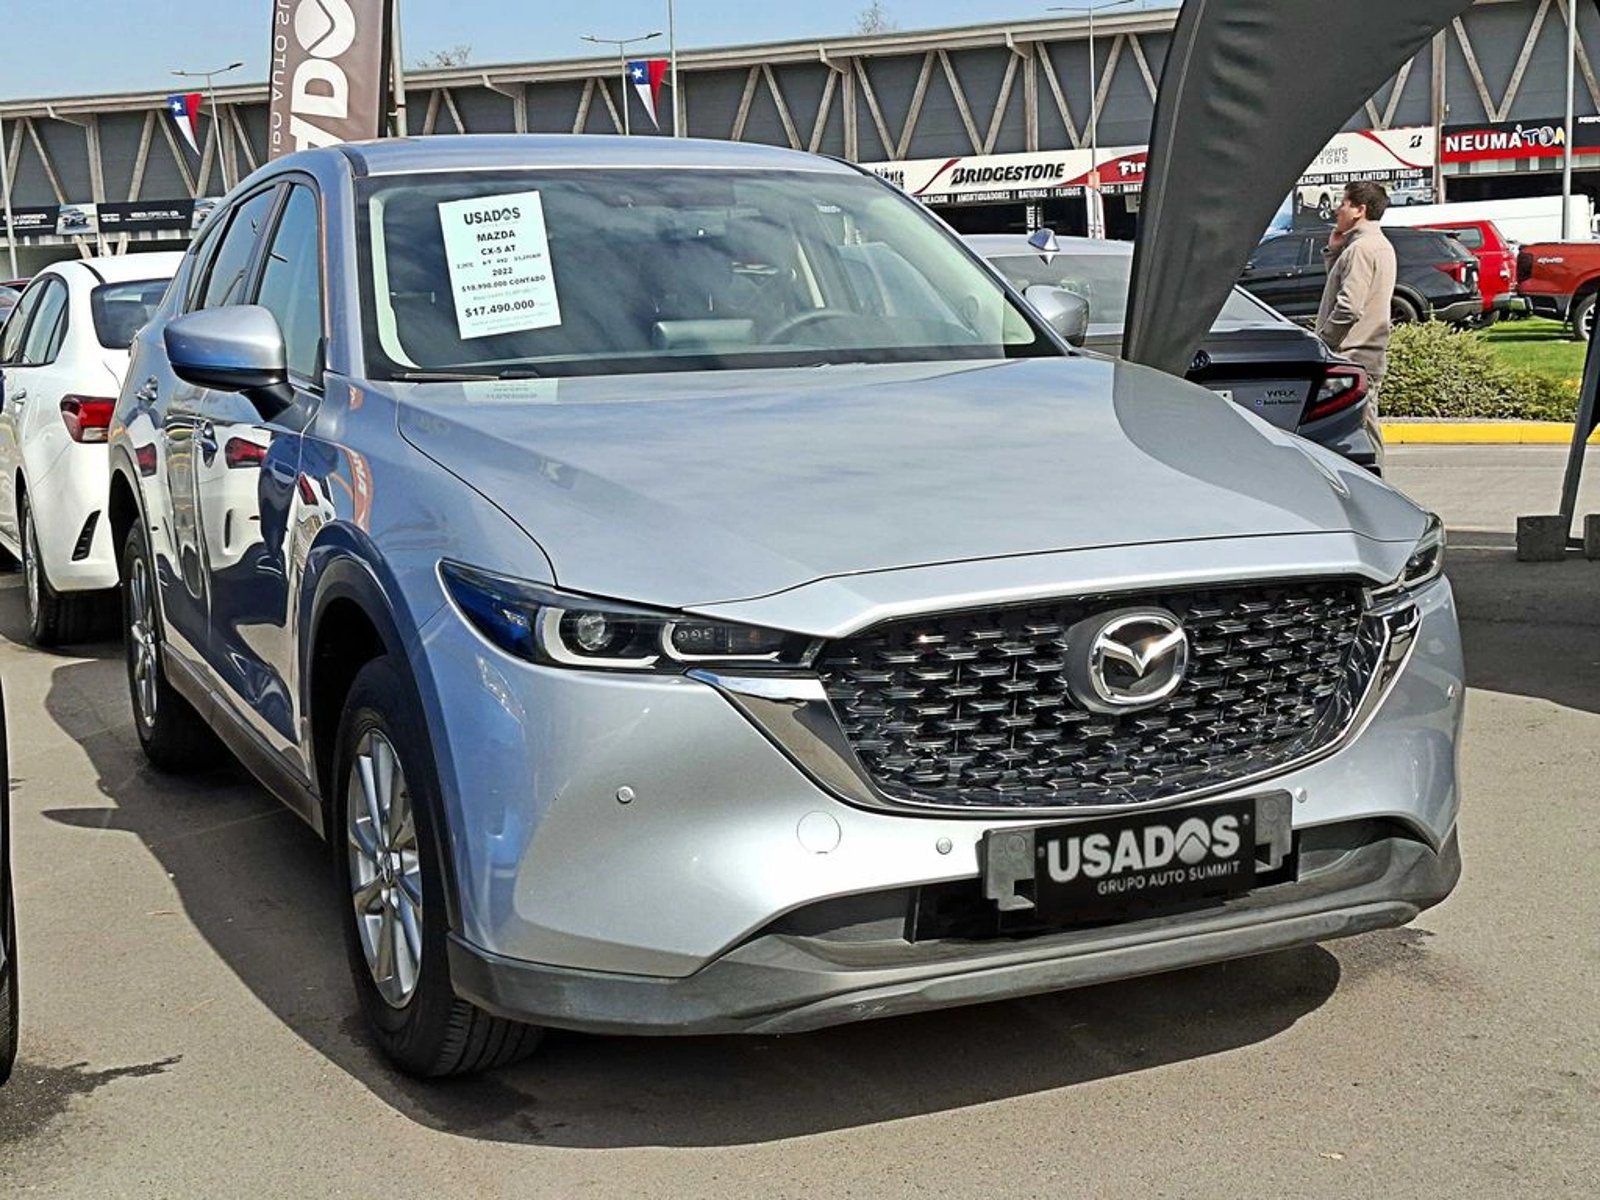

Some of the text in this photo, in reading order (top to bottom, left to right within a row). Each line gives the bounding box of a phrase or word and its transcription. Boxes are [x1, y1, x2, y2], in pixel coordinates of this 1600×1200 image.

[951, 163, 1066, 185] BRIDGESTONE
[463, 207, 521, 225] USADOS
[477, 229, 516, 243] MAZDA
[481, 244, 516, 256] CX-5 AT
[492, 266, 513, 277] 2022
[509, 275, 546, 286] CONTADO
[465, 299, 535, 318] $17.490.000
[1047, 814, 1241, 883] USADOS
[1097, 861, 1241, 895] GRUPO AUTO SUMMIT
